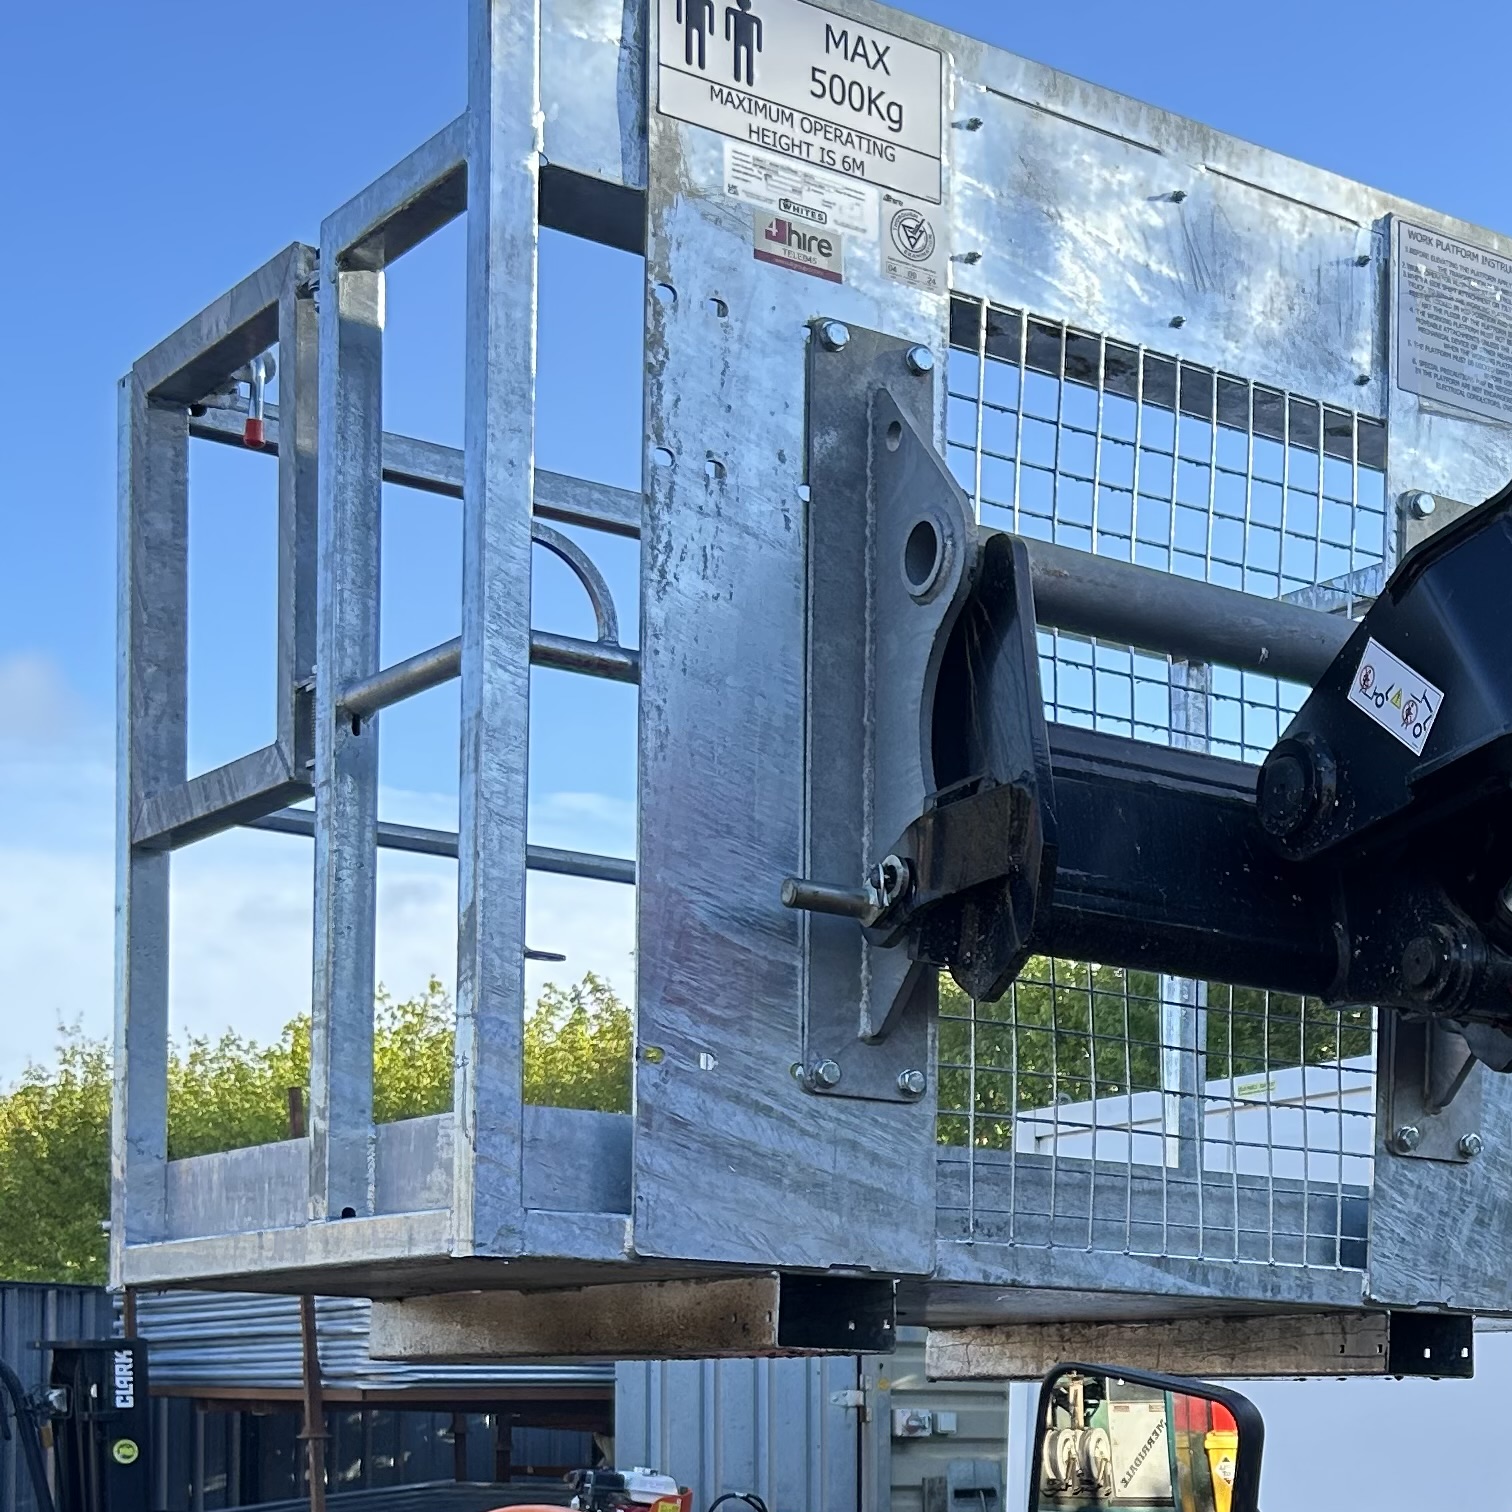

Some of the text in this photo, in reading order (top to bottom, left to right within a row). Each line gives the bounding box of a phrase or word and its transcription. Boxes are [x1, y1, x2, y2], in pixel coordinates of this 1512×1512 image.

[825, 24, 891, 77] MAX
[709, 85, 896, 163] MAXIMUM OPERATING
[809, 66, 904, 133] 500Kg
[748, 123, 866, 177] HEIGHT IS 6M
[781, 200, 824, 221] WHITES
[1408, 229, 1433, 248] WORK
[1436, 239, 1479, 264] PLATFORM
[114, 1348, 135, 1409] CLARK
